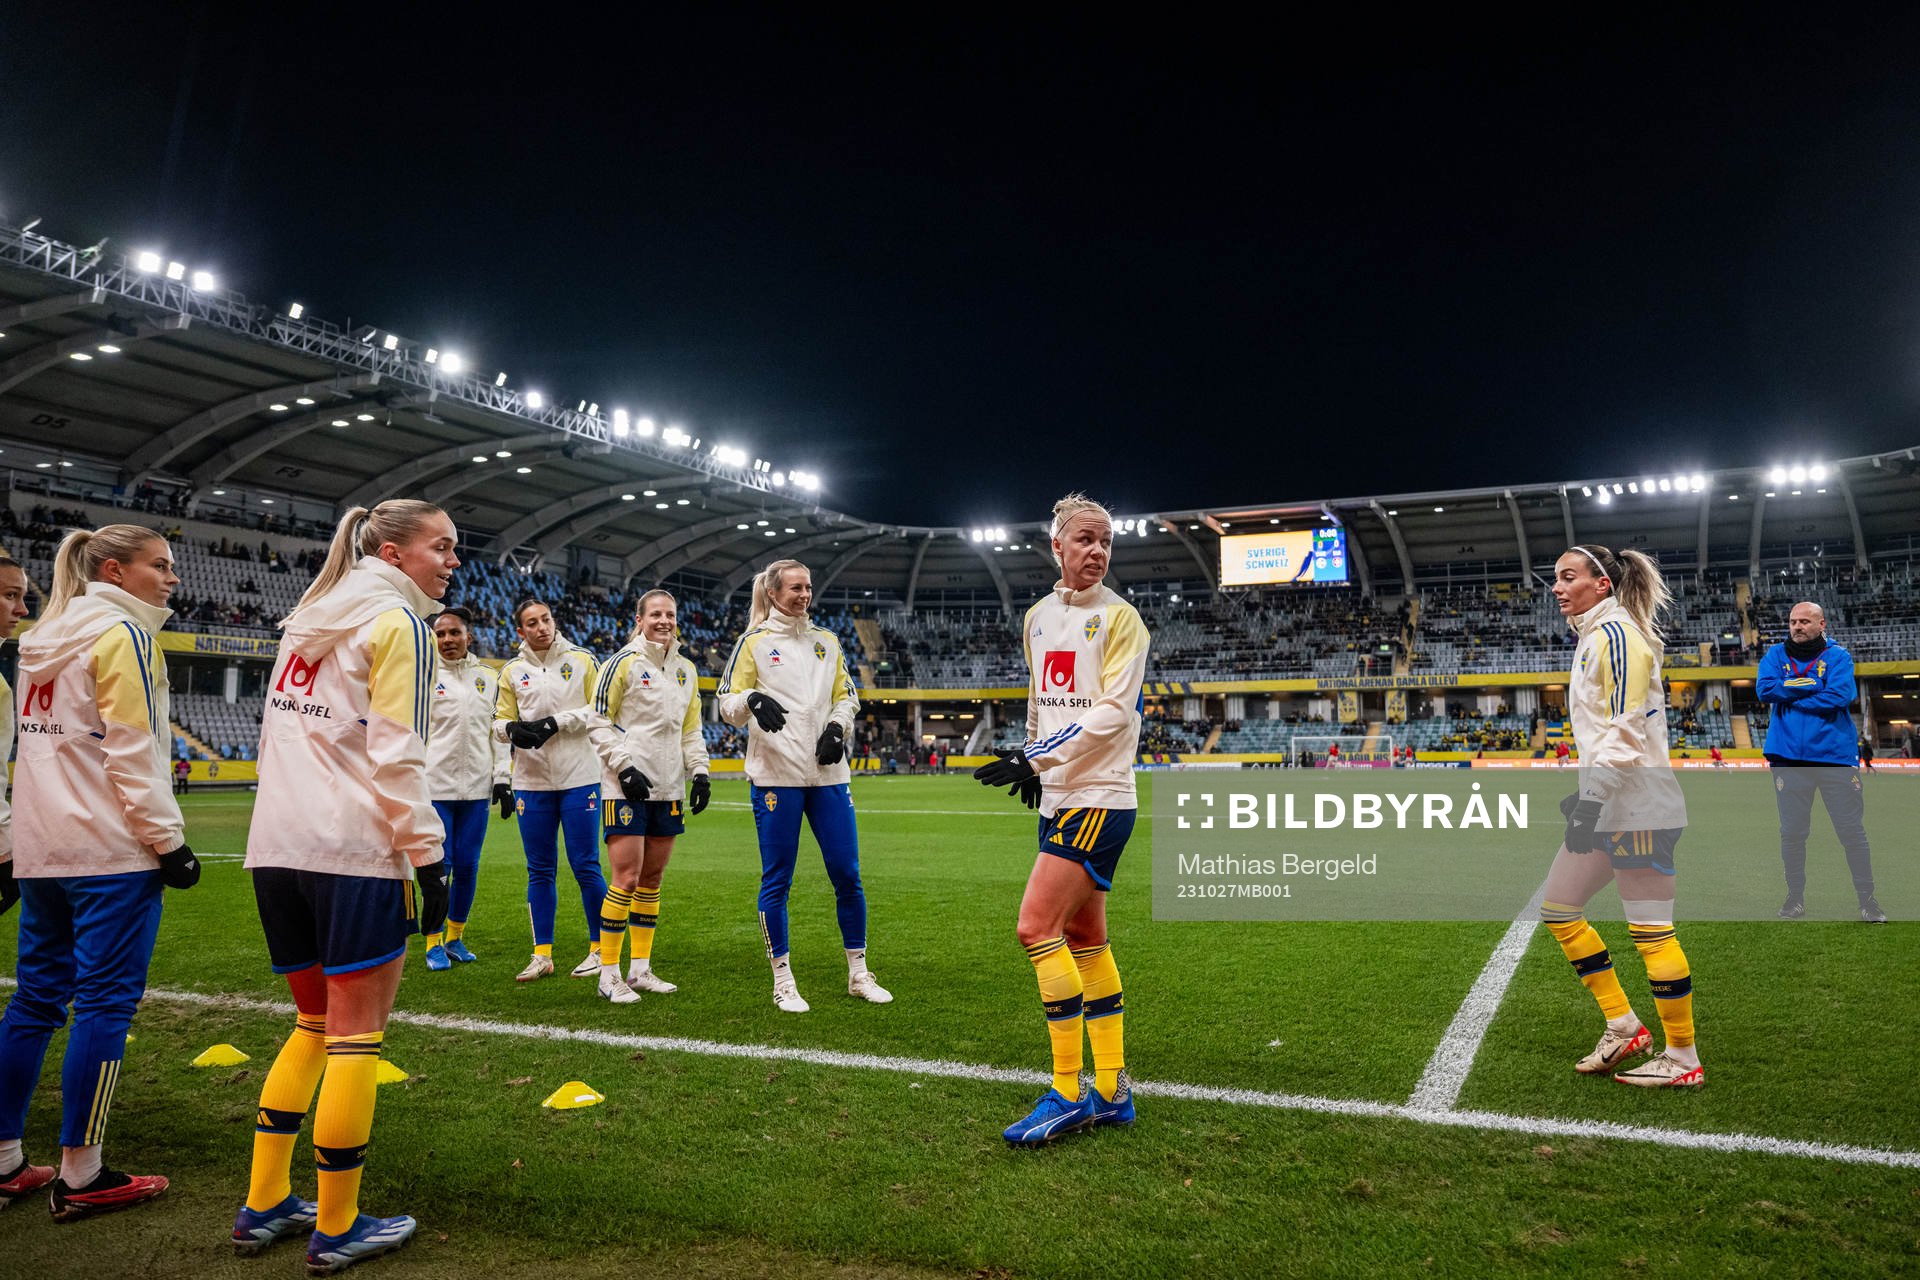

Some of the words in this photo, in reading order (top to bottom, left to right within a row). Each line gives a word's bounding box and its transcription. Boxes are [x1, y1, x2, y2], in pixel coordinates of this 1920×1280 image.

[30, 414, 72, 429] D5
[1247, 547, 1287, 558] SVERIGE
[1245, 558, 1289, 570] SCHWEIZ
[1396, 677, 1427, 687] GAMLA
[1428, 675, 1458, 686] ULLEVI
[301, 703, 332, 719] SPEL
